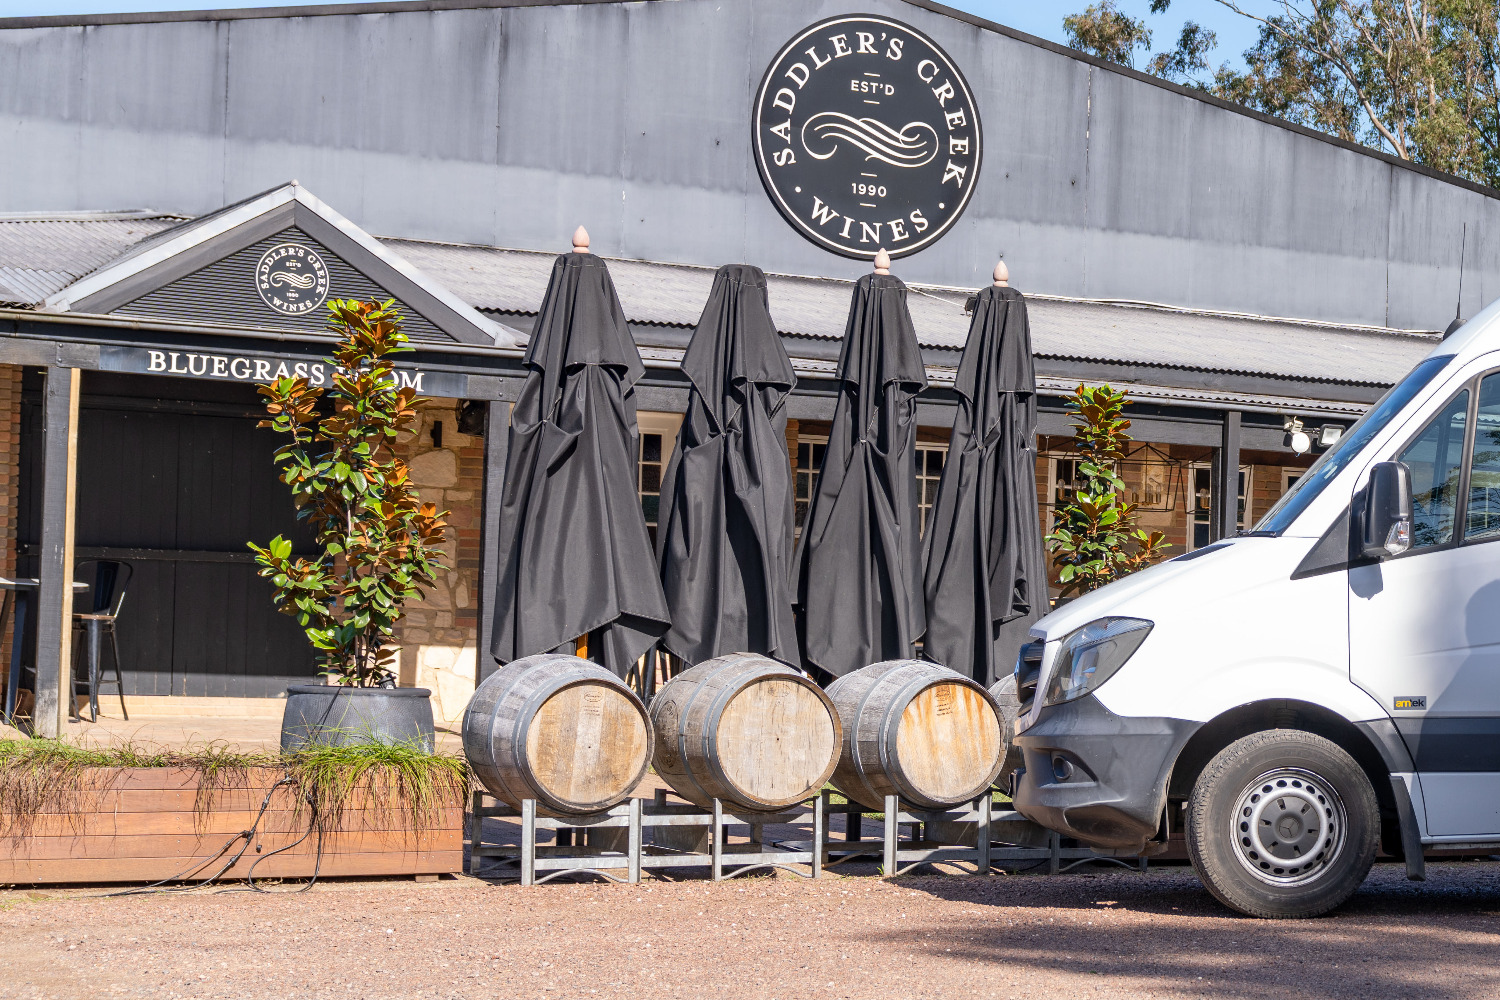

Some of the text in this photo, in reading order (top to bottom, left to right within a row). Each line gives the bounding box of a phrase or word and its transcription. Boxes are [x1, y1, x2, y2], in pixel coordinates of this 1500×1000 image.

[851, 80, 895, 96] EST'D
[770, 31, 969, 188] SADDLER'S CREEK
[851, 183, 887, 197] 1990
[810, 196, 928, 244] WINES
[260, 247, 326, 294] SADDLER'S CREEK
[273, 296, 312, 311] WINES
[147, 350, 325, 385] BLUEGRASS
